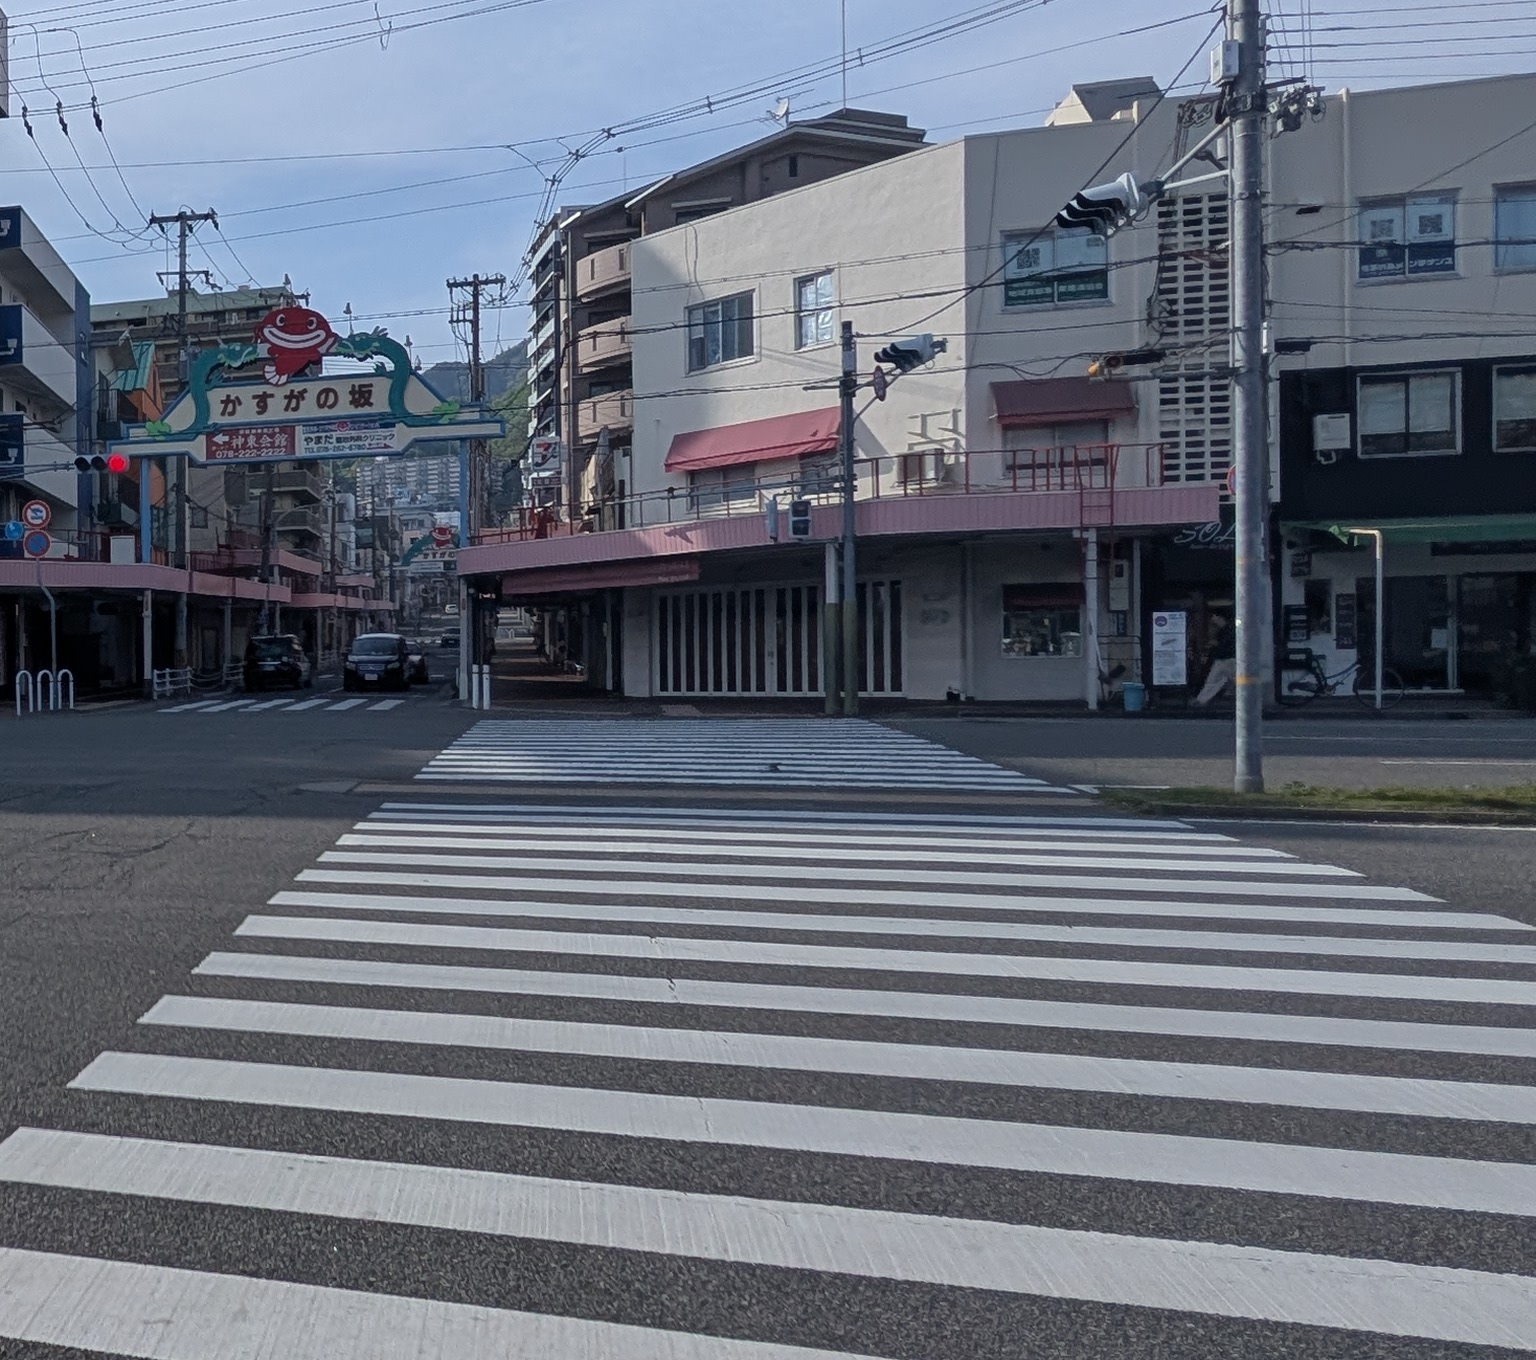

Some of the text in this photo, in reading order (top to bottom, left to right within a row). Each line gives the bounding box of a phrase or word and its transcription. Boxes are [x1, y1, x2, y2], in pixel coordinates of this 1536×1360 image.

[220, 383, 374, 417] かすがの坂
[230, 433, 289, 449] 神東会館
[304, 433, 334, 446] やまだ
[216, 447, 286, 459] 078-222-2222
